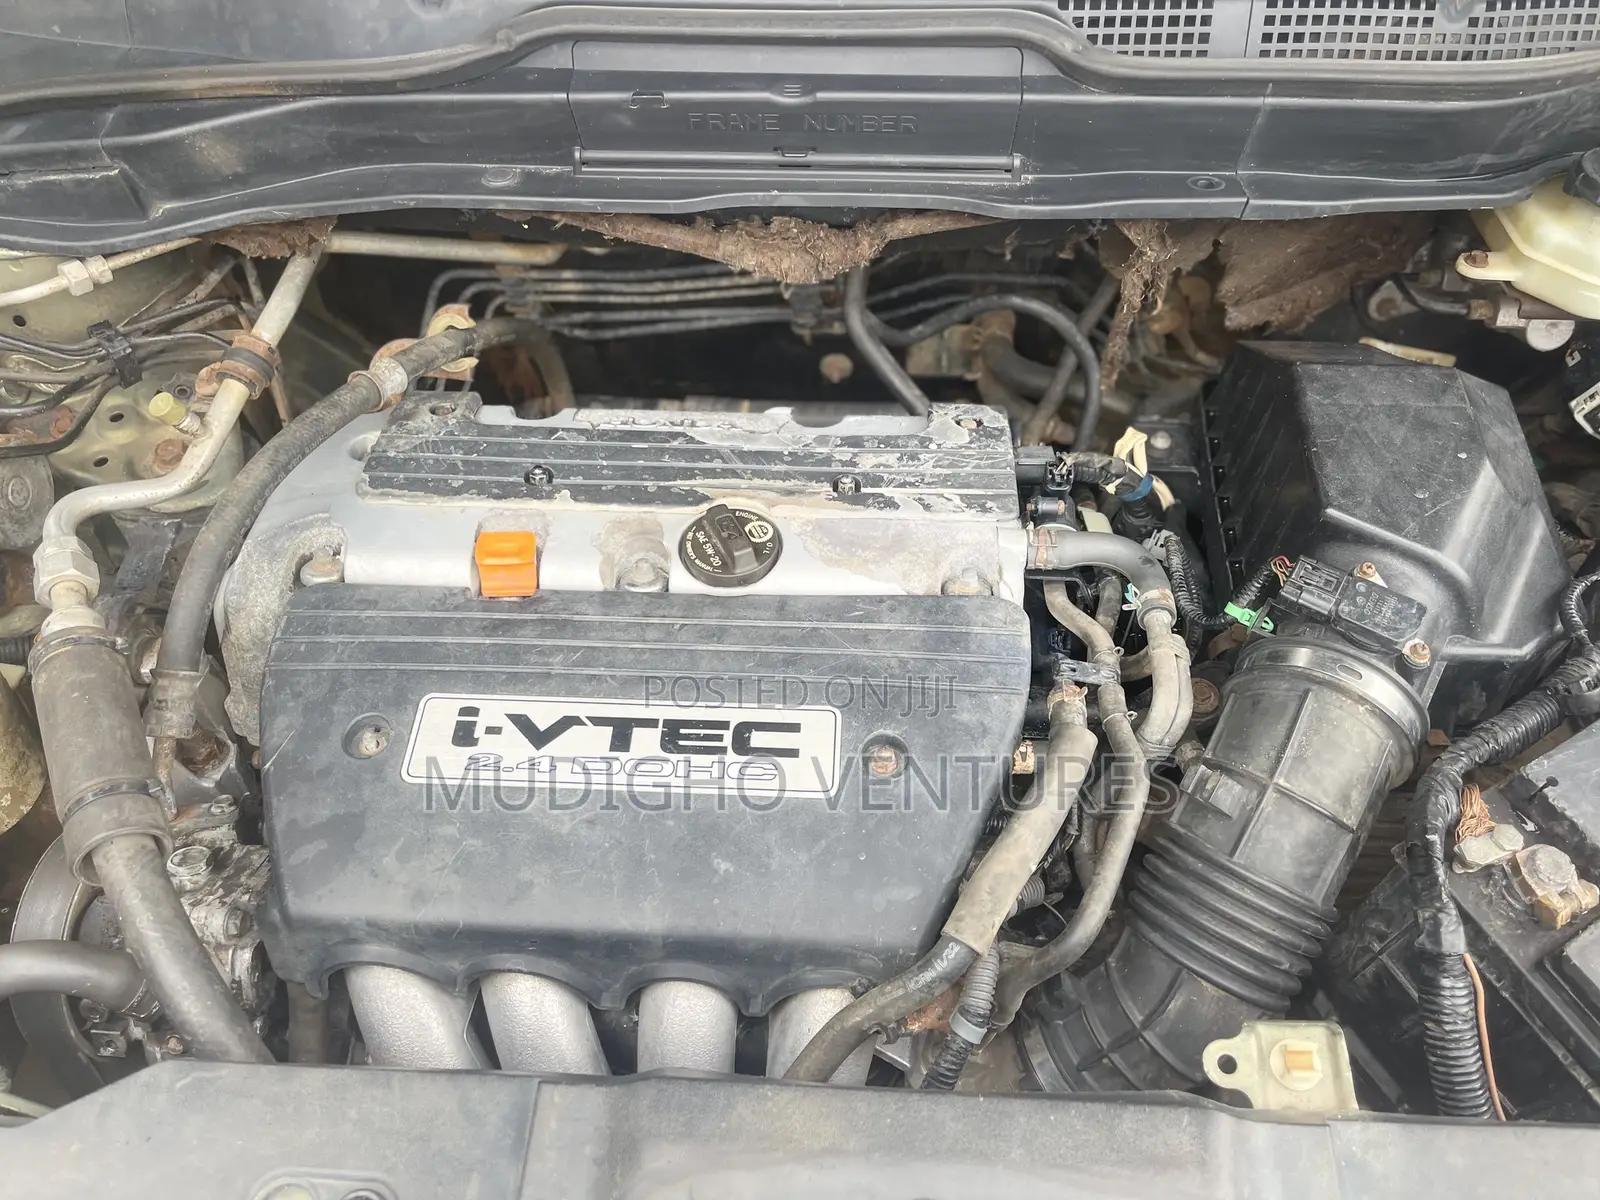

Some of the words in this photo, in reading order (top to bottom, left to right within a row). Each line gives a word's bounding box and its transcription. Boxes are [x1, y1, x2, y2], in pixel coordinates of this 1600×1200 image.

[688, 113, 780, 130] FRAME
[803, 114, 917, 132] NUMBER
[735, 511, 759, 521] ENGINE
[696, 530, 709, 544] SAE
[703, 543, 722, 567] 5W-20
[451, 706, 801, 758] i-VTEC
[465, 752, 557, 774] 2.4
[571, 756, 778, 781] DOHC
